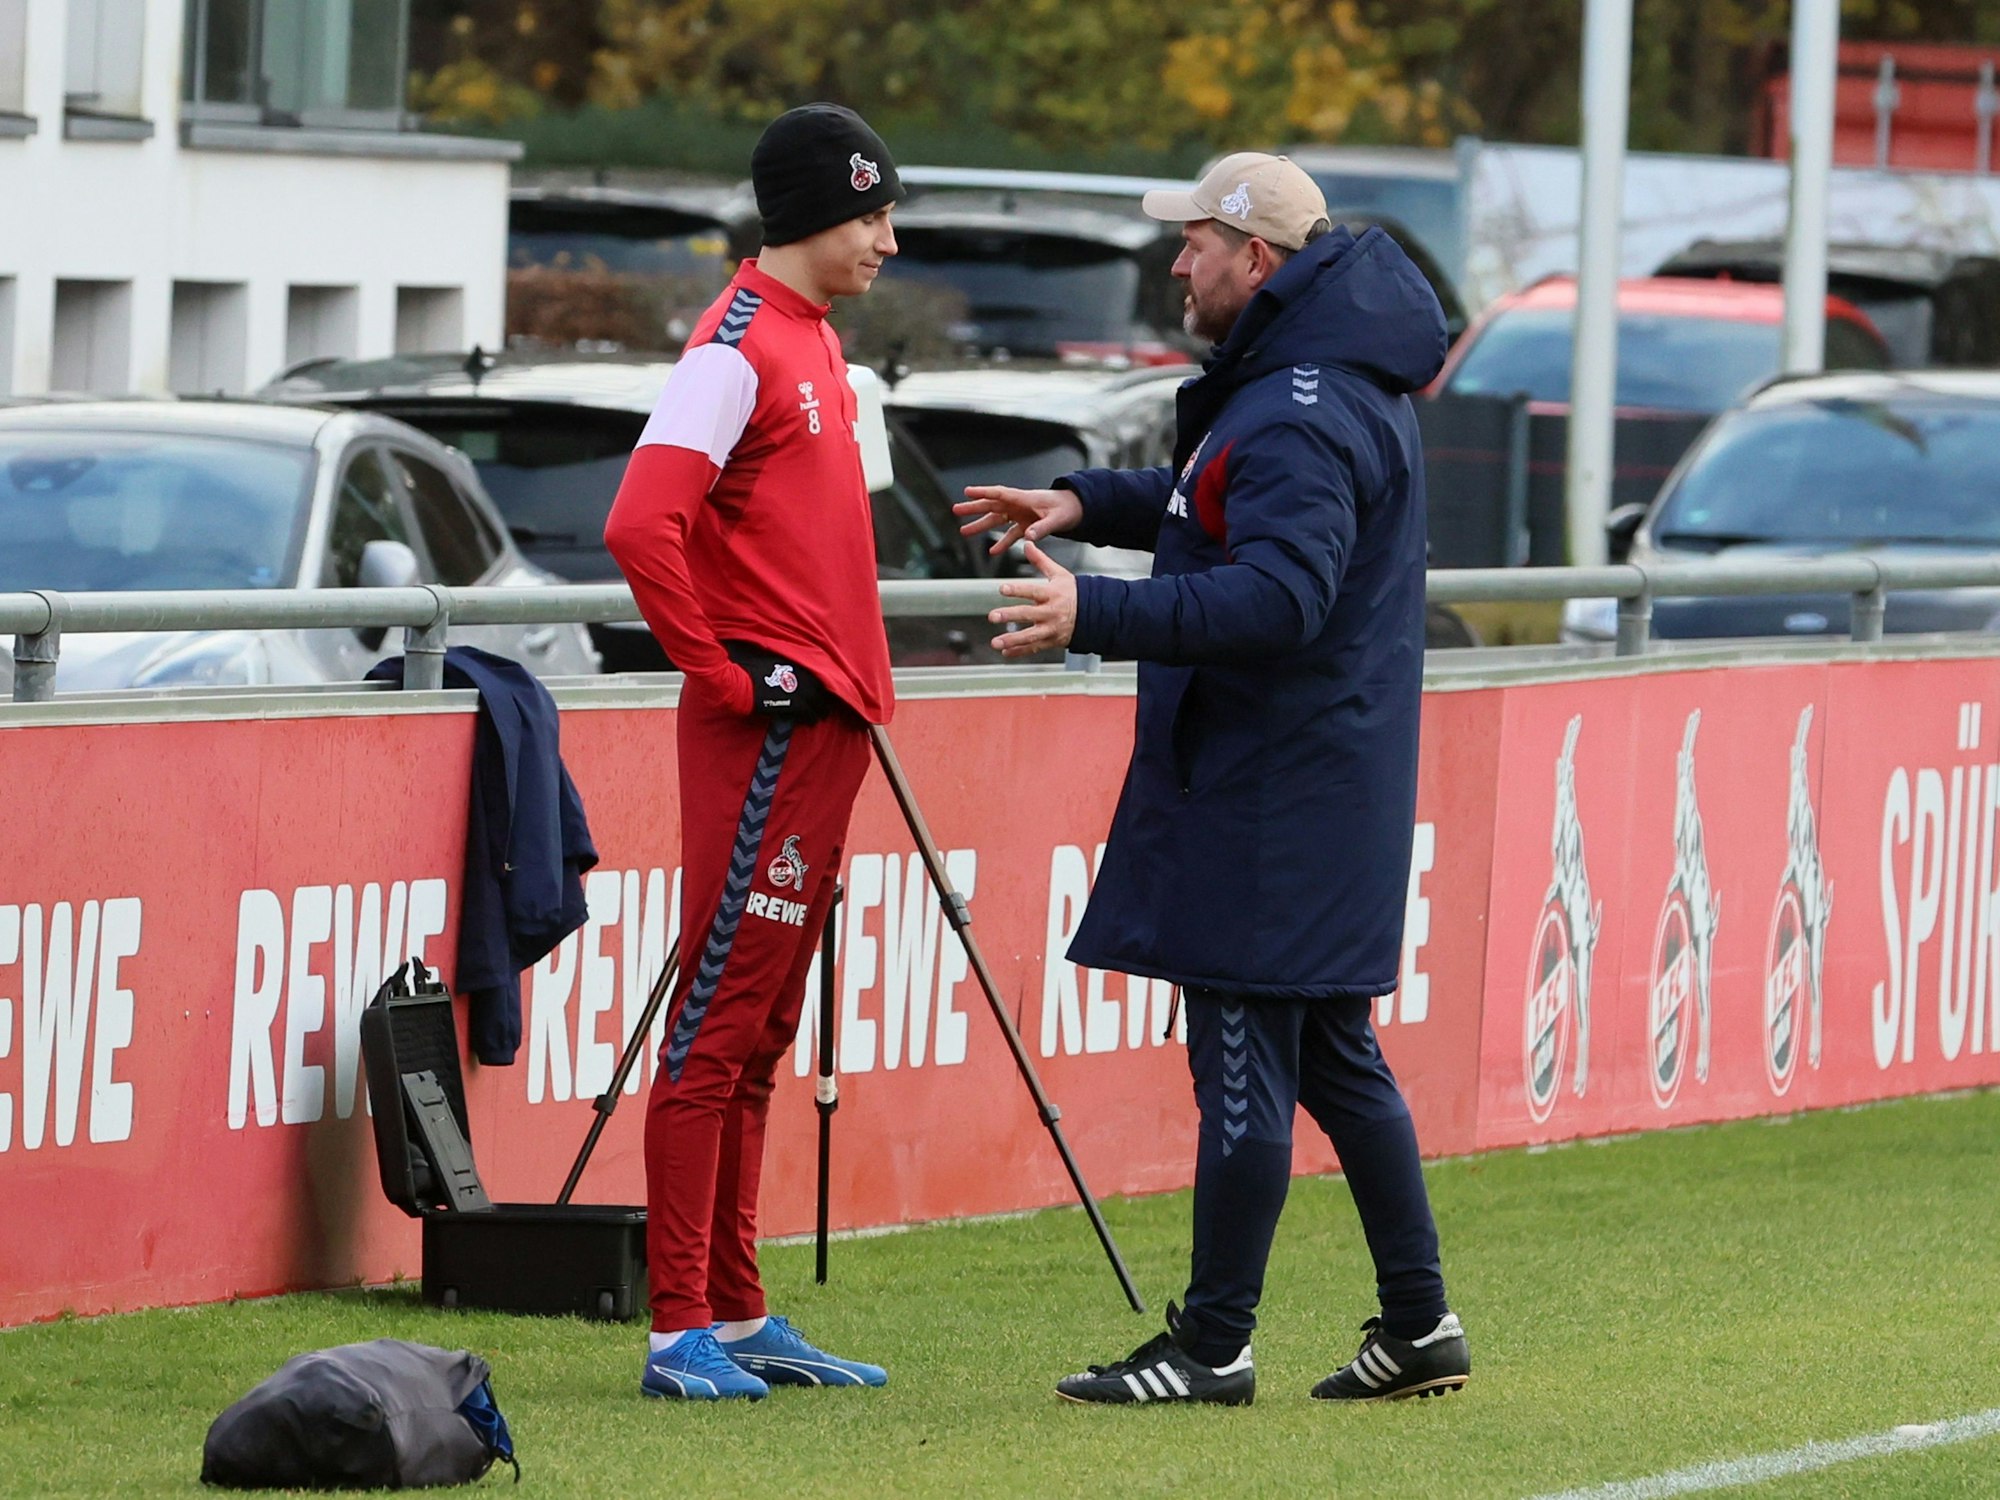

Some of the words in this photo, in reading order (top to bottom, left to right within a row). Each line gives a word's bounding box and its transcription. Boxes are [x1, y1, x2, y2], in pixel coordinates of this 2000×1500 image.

[808, 409, 820, 434] 8
[746, 890, 808, 927] REWE
[527, 866, 683, 1104] REW
